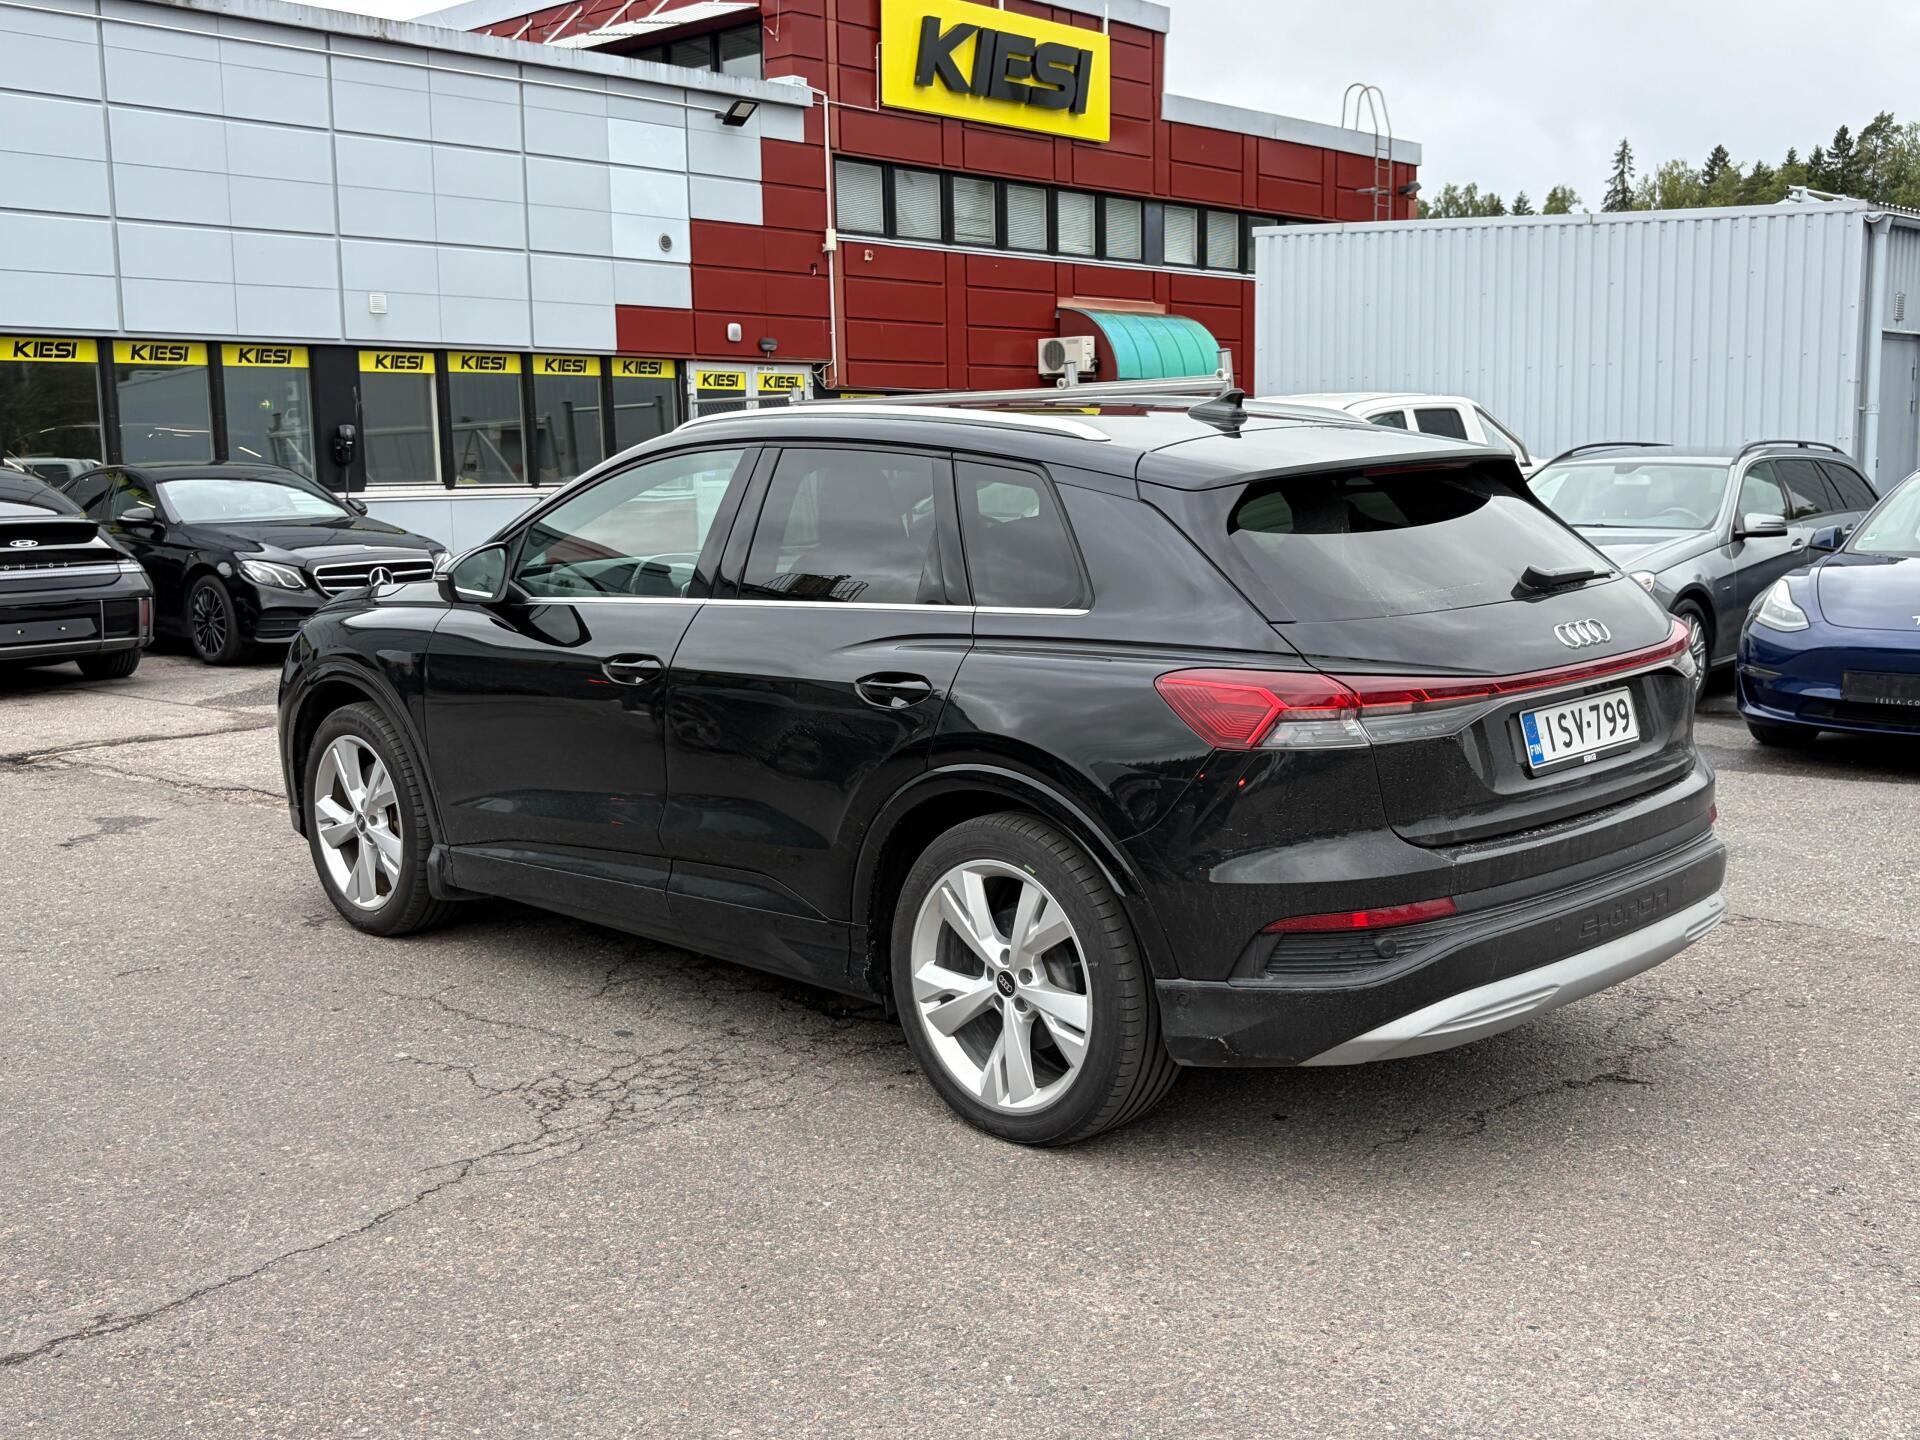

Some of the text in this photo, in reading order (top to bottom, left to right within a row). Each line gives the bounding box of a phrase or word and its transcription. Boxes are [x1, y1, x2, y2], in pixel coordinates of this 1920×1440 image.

[914, 15, 1093, 114] KIESI
[13, 341, 77, 359] KIESI
[130, 344, 189, 362] KIESI
[238, 347, 292, 364] KIESI
[375, 354, 424, 370] KIESI
[461, 355, 507, 370] KIESI
[544, 358, 587, 373] KIESI
[622, 360, 662, 375] KIESI
[702, 373, 739, 387] KIESI
[763, 375, 799, 388] KIESI
[1545, 698, 1630, 752] ISV-799
[1530, 744, 1542, 756] FIN
